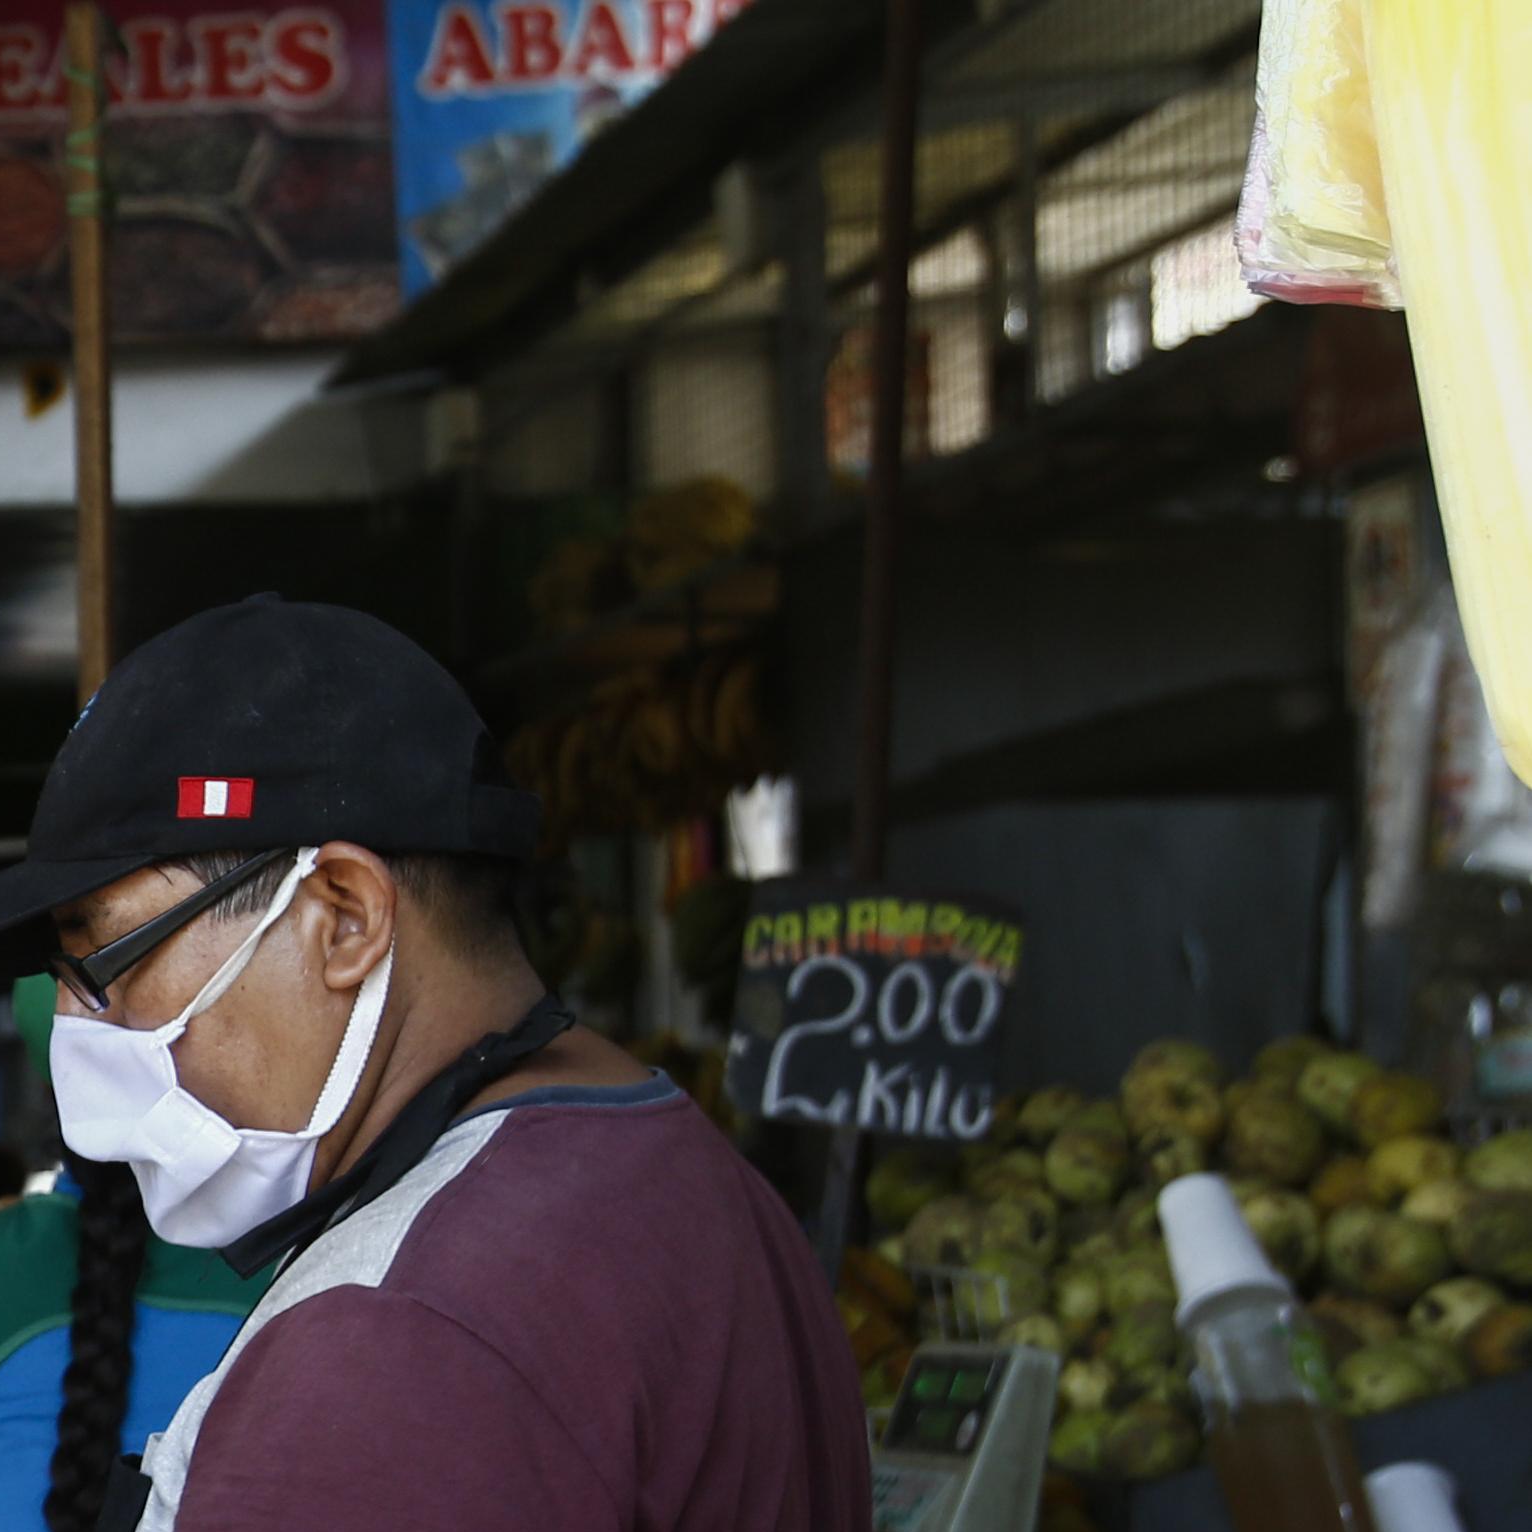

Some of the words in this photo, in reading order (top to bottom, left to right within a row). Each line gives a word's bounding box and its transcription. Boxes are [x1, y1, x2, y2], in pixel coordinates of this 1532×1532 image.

[429, 0, 734, 82] ABAR
[762, 955, 1000, 1126] 2.00
[856, 1058, 996, 1141] Kilo
